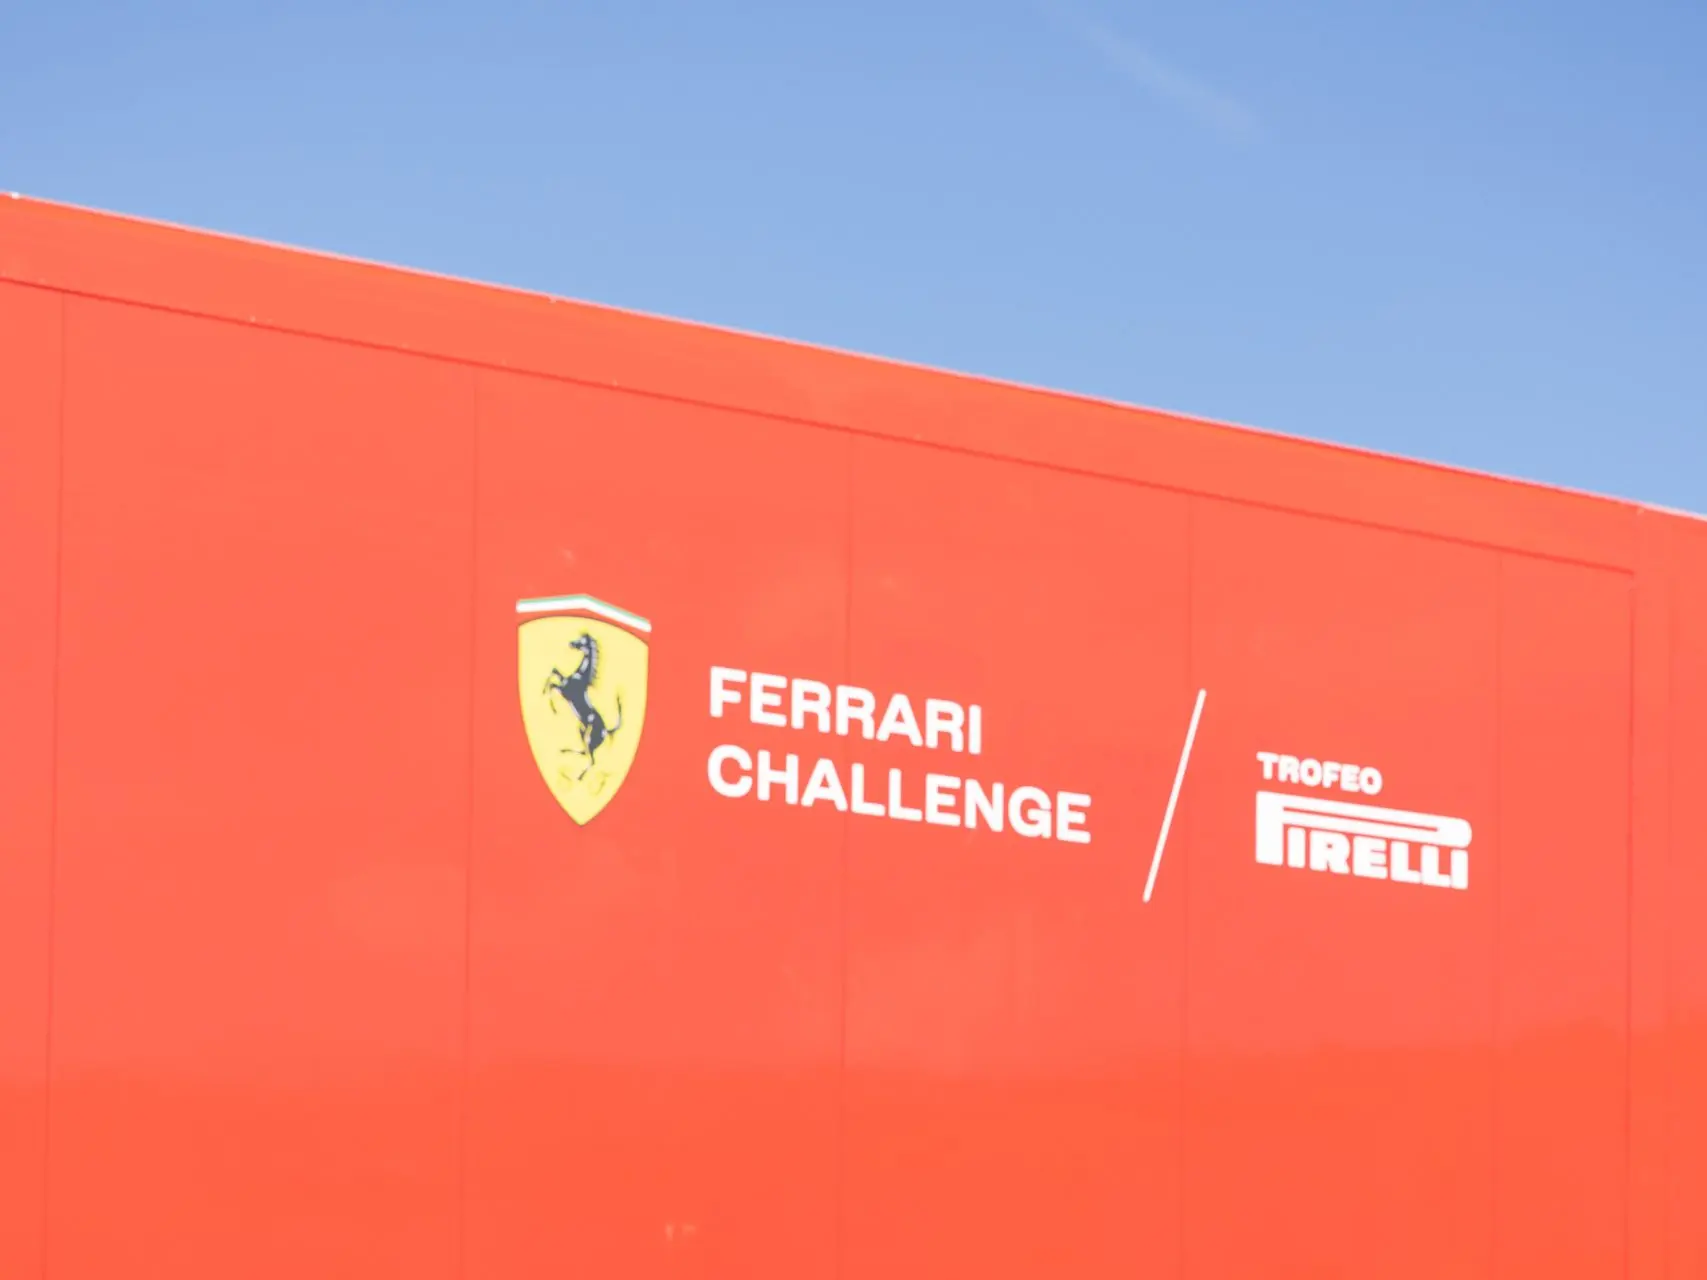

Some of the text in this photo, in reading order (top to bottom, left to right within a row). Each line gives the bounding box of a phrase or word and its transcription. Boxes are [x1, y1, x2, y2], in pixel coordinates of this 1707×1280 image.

[709, 665, 982, 755] FERRARI
[707, 744, 1092, 844] CHALLENGE
[1256, 751, 1382, 795] TROFEO
[1255, 790, 1472, 890] PIRELLI
